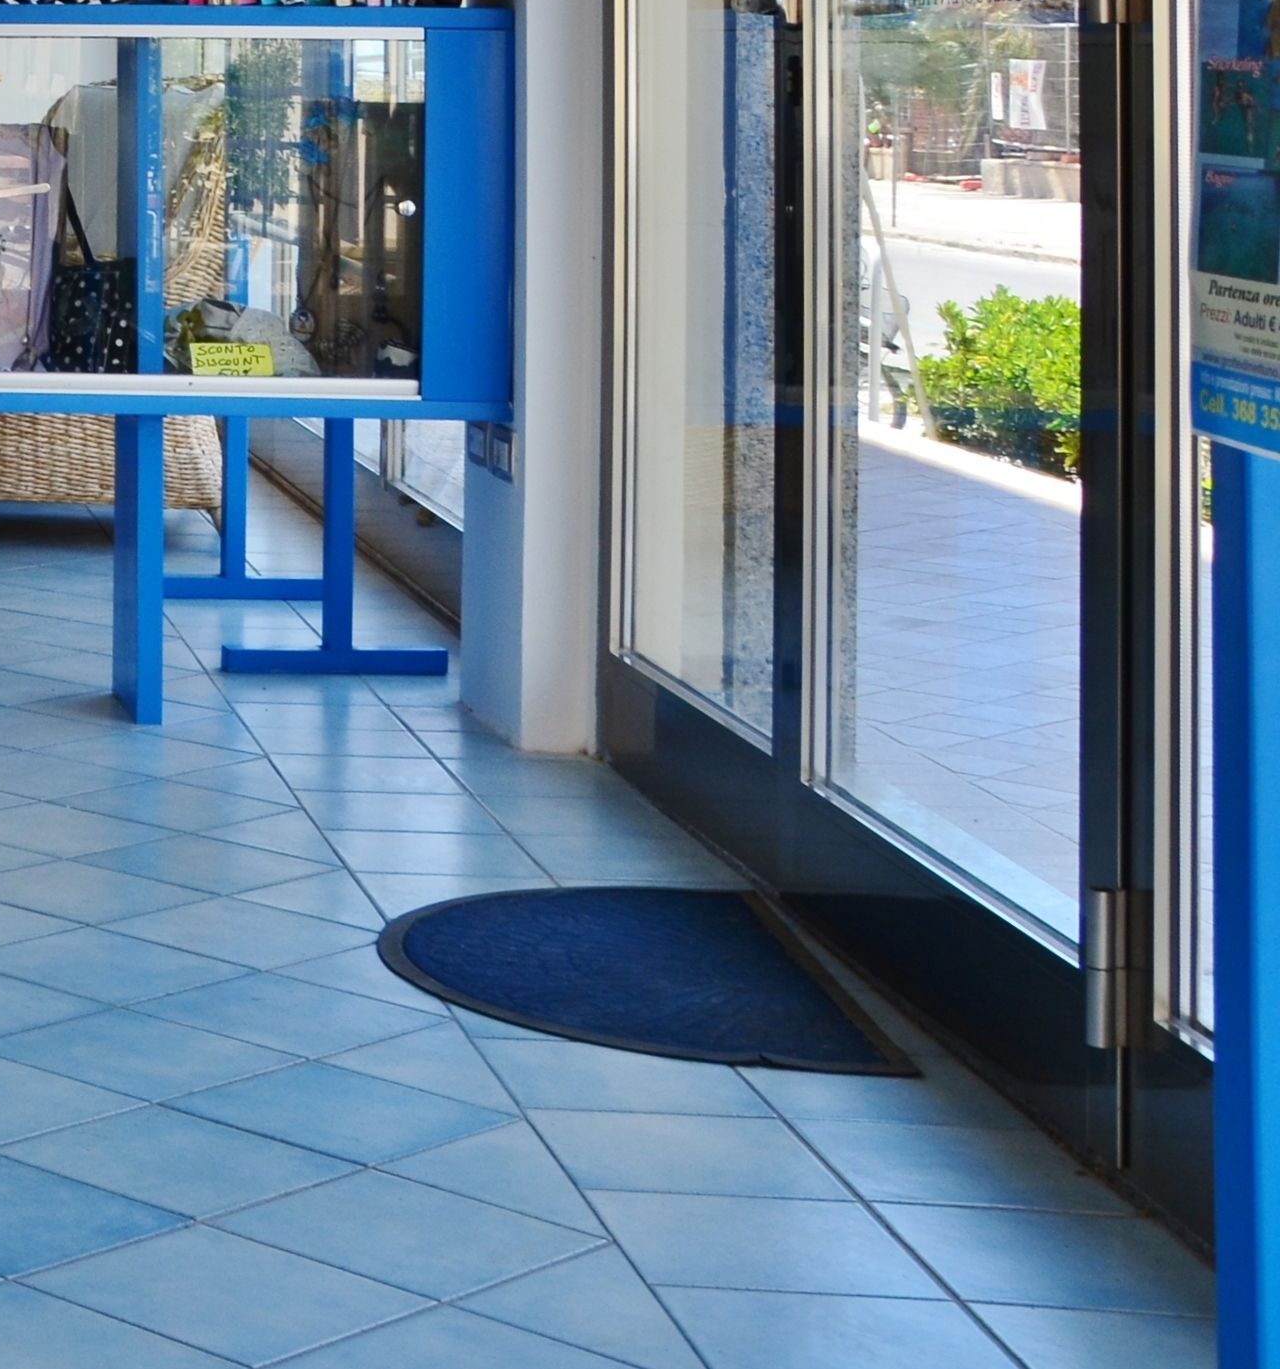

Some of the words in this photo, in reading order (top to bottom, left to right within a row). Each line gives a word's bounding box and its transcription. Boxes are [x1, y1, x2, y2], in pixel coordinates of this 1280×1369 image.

[1208, 279, 1261, 303] Partenza
[1234, 309, 1266, 331] Adulti
[196, 344, 256, 357] SCONTO
[194, 355, 266, 368] DISCOUNT
